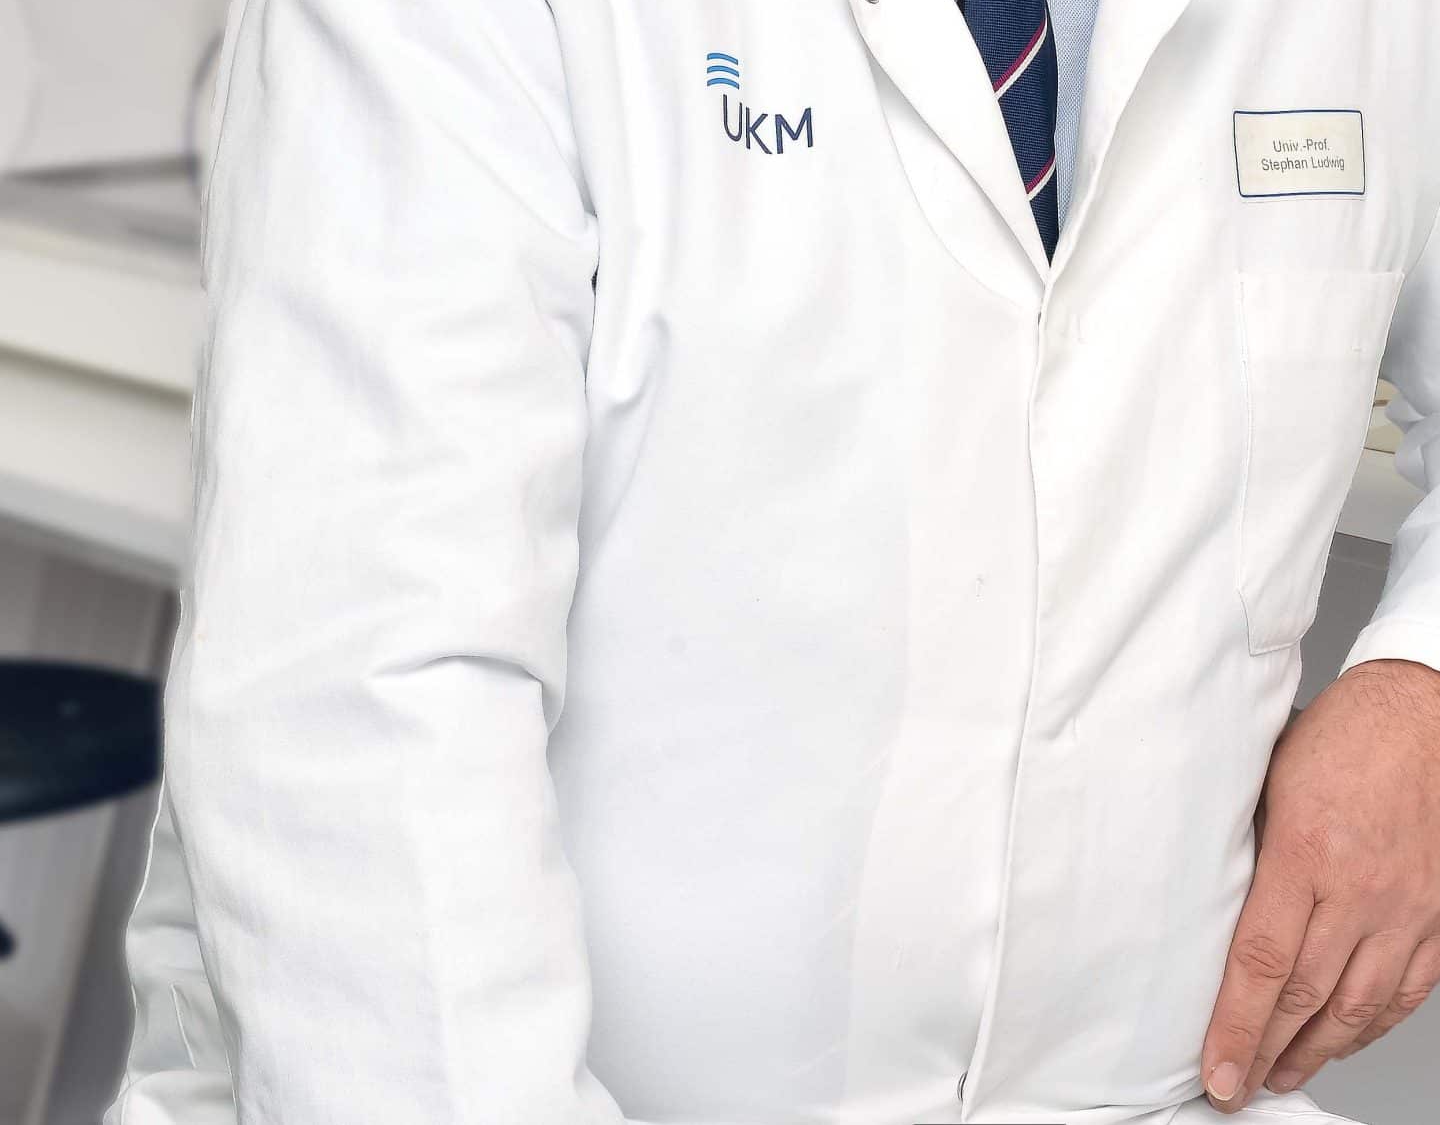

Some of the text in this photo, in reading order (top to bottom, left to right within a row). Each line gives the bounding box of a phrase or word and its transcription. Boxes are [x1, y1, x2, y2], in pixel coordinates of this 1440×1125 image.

[722, 93, 814, 155] UKM
[1261, 156, 1345, 174] Stephan Ludwig
